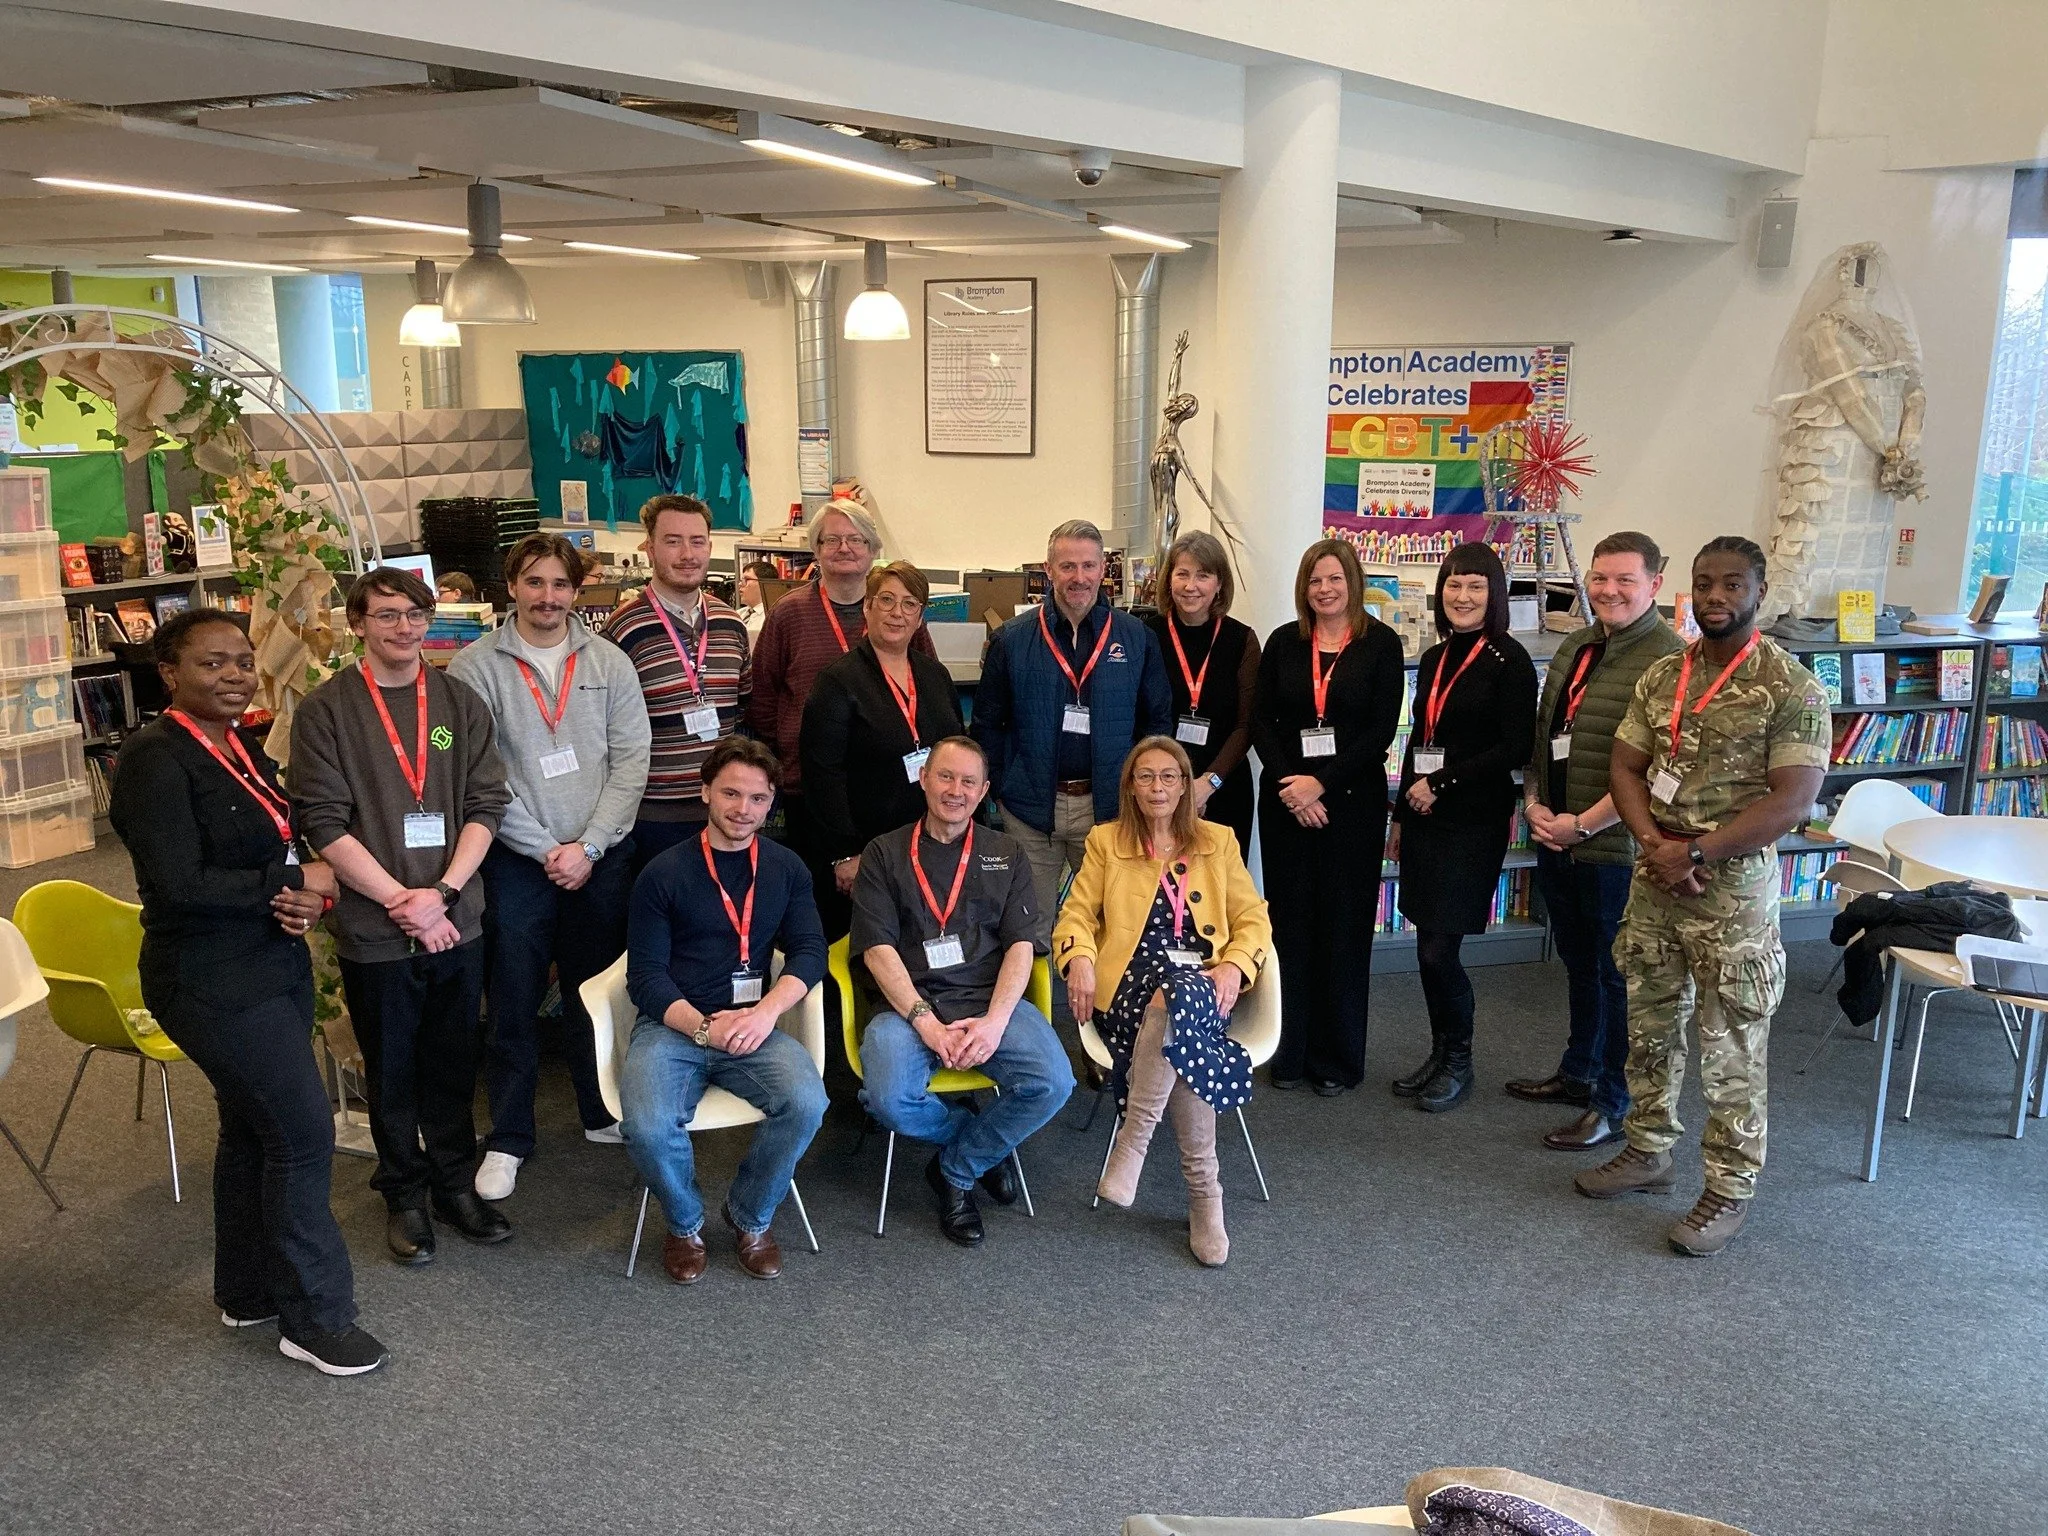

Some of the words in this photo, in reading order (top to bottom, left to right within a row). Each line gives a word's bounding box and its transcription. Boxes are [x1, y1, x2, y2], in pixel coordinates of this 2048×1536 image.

[966, 286, 1005, 297] Brompton
[1407, 350, 1534, 379] Academy
[1328, 383, 1468, 406] Celebrates
[1366, 479, 1399, 487] Brompton
[1400, 480, 1431, 488] Academy
[1401, 488, 1431, 496] Diversity
[1945, 651, 1973, 664] KID
